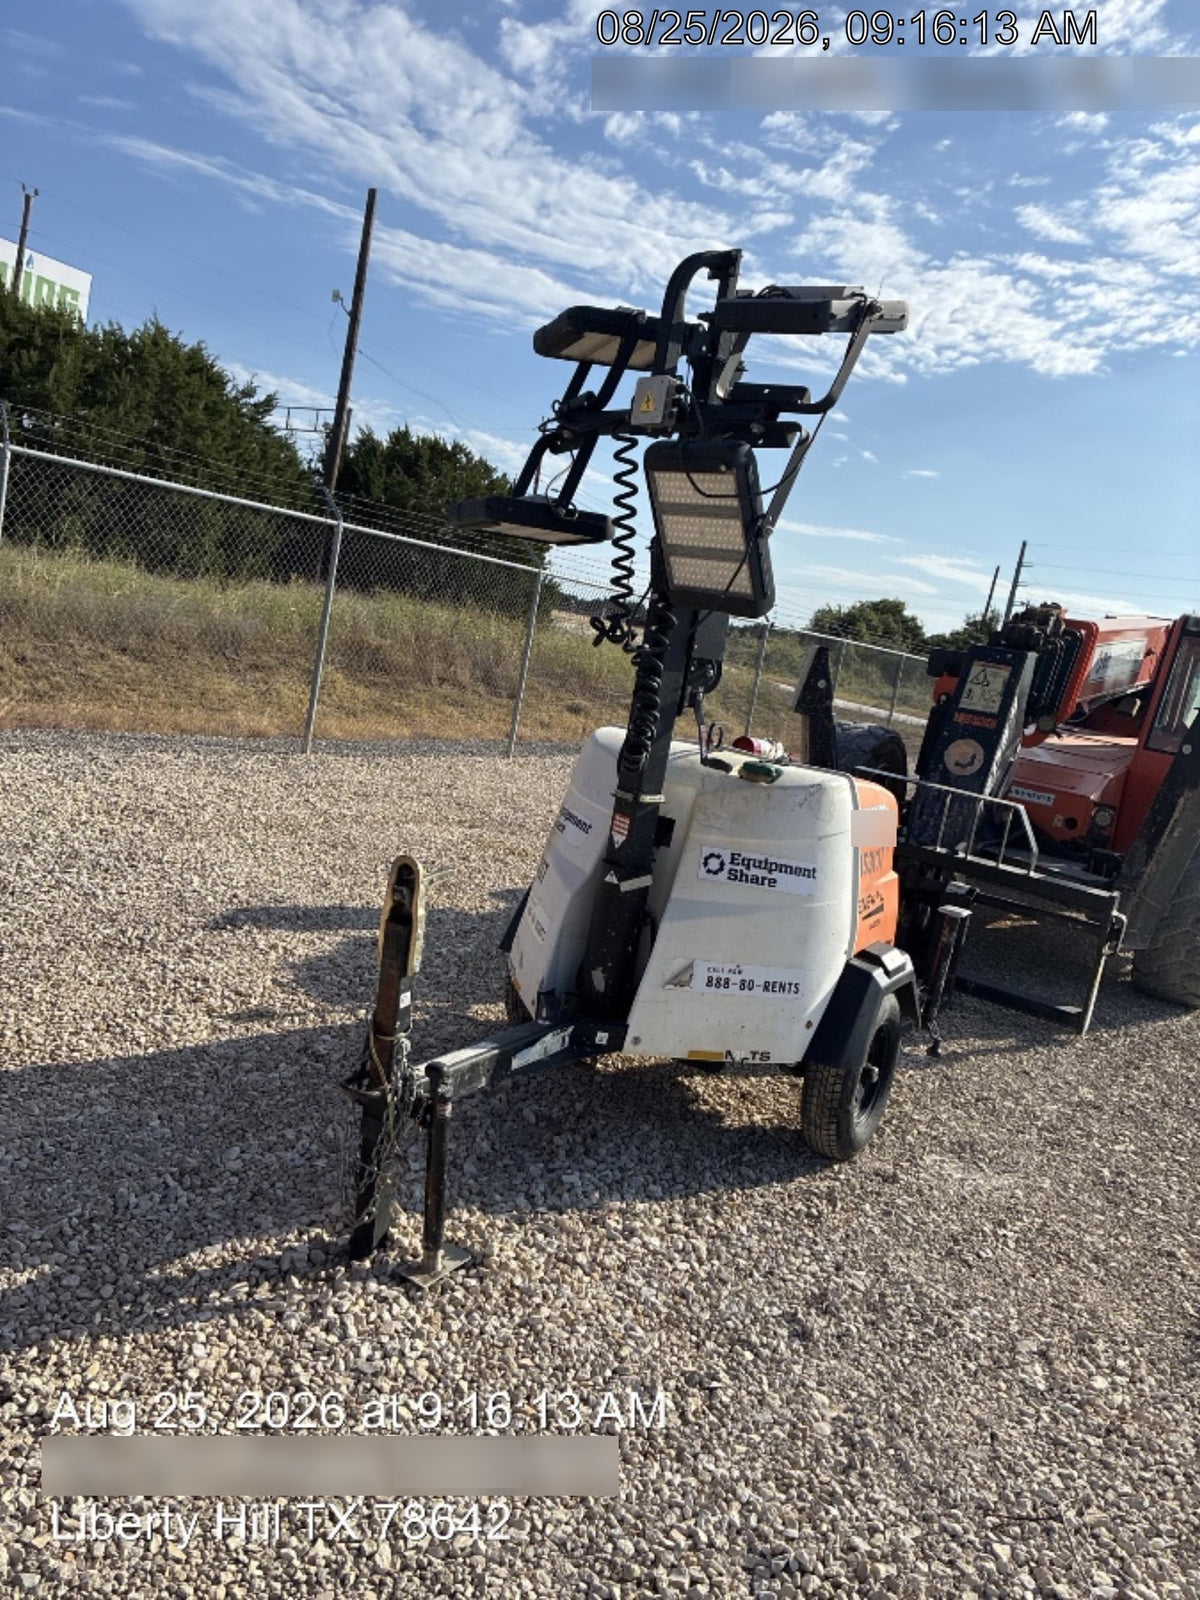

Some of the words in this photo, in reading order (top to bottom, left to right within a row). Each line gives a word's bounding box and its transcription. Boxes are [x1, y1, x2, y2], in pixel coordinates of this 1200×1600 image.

[728, 852, 817, 879] Equipment
[726, 867, 778, 888] Share
[705, 975, 800, 995] 888-80-RENTS
